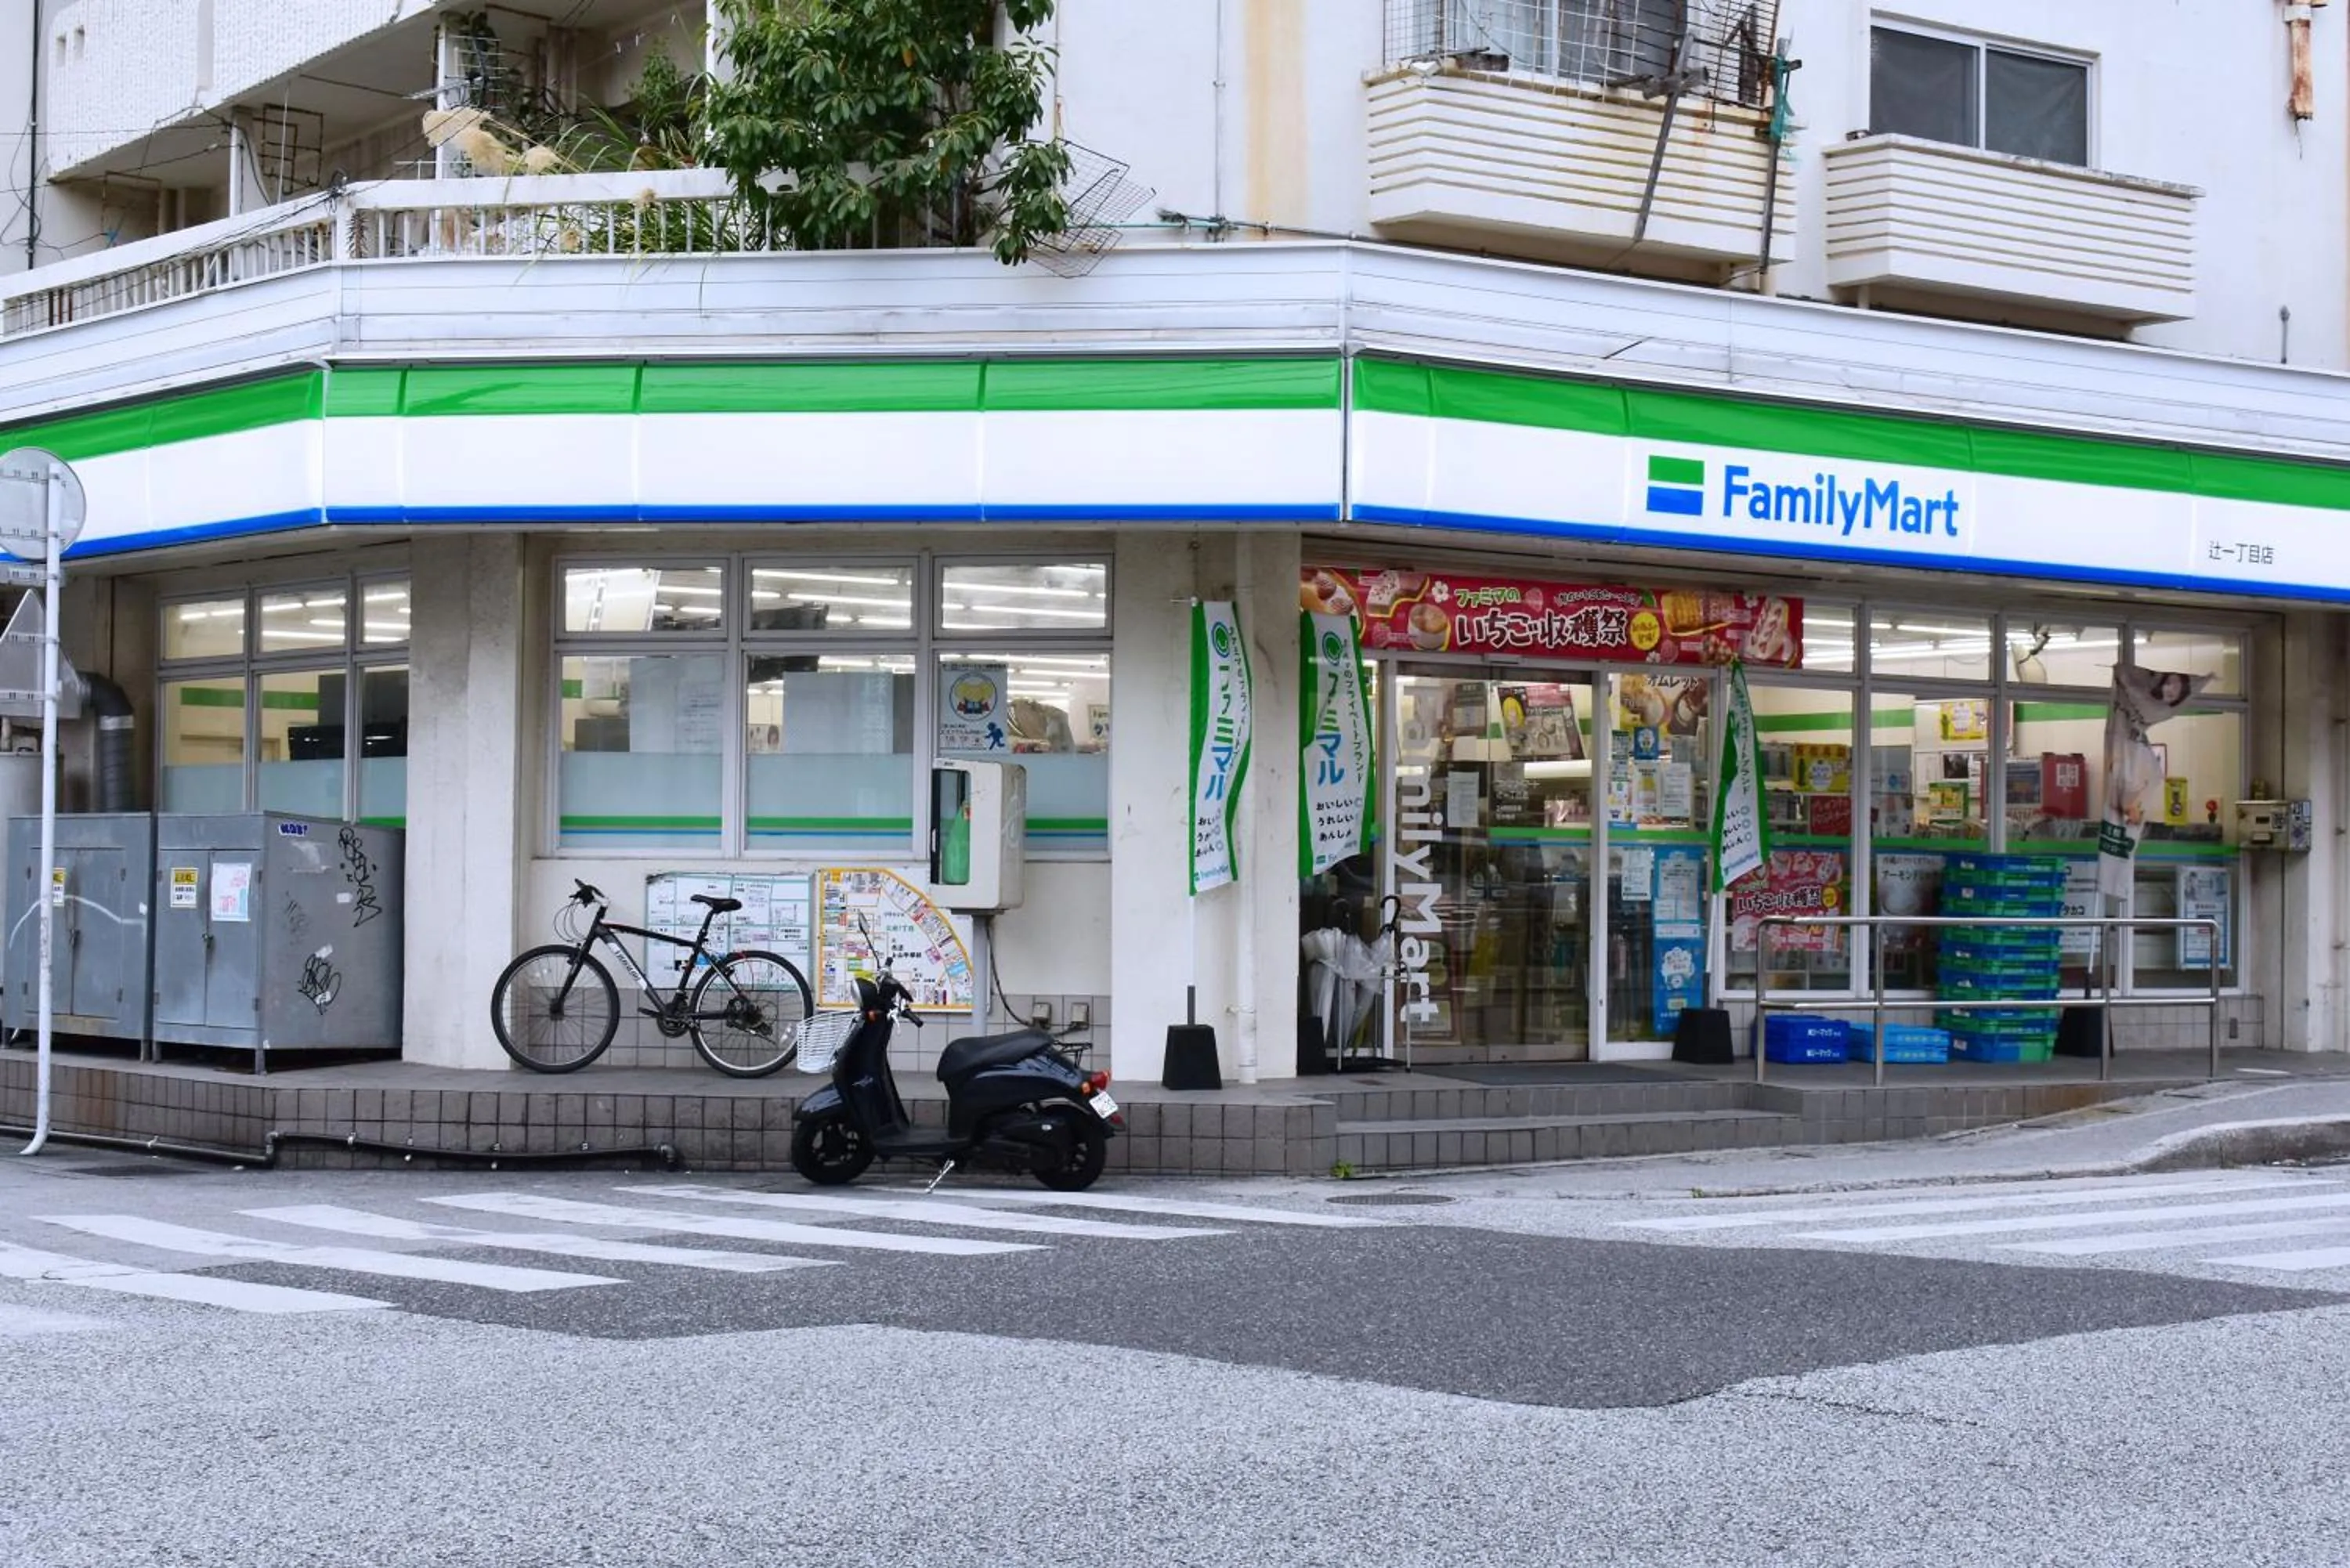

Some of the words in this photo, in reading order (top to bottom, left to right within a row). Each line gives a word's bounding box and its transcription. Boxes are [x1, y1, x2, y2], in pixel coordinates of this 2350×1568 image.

[1723, 464, 1959, 537] FamilyMart
[2209, 540, 2275, 564] 辻一丁目店
[1455, 587, 1520, 608] ファミマの
[1455, 605, 1627, 649] いちご収穫祭
[1316, 799, 1353, 811] おいしい
[1318, 815, 1354, 826] うれしい
